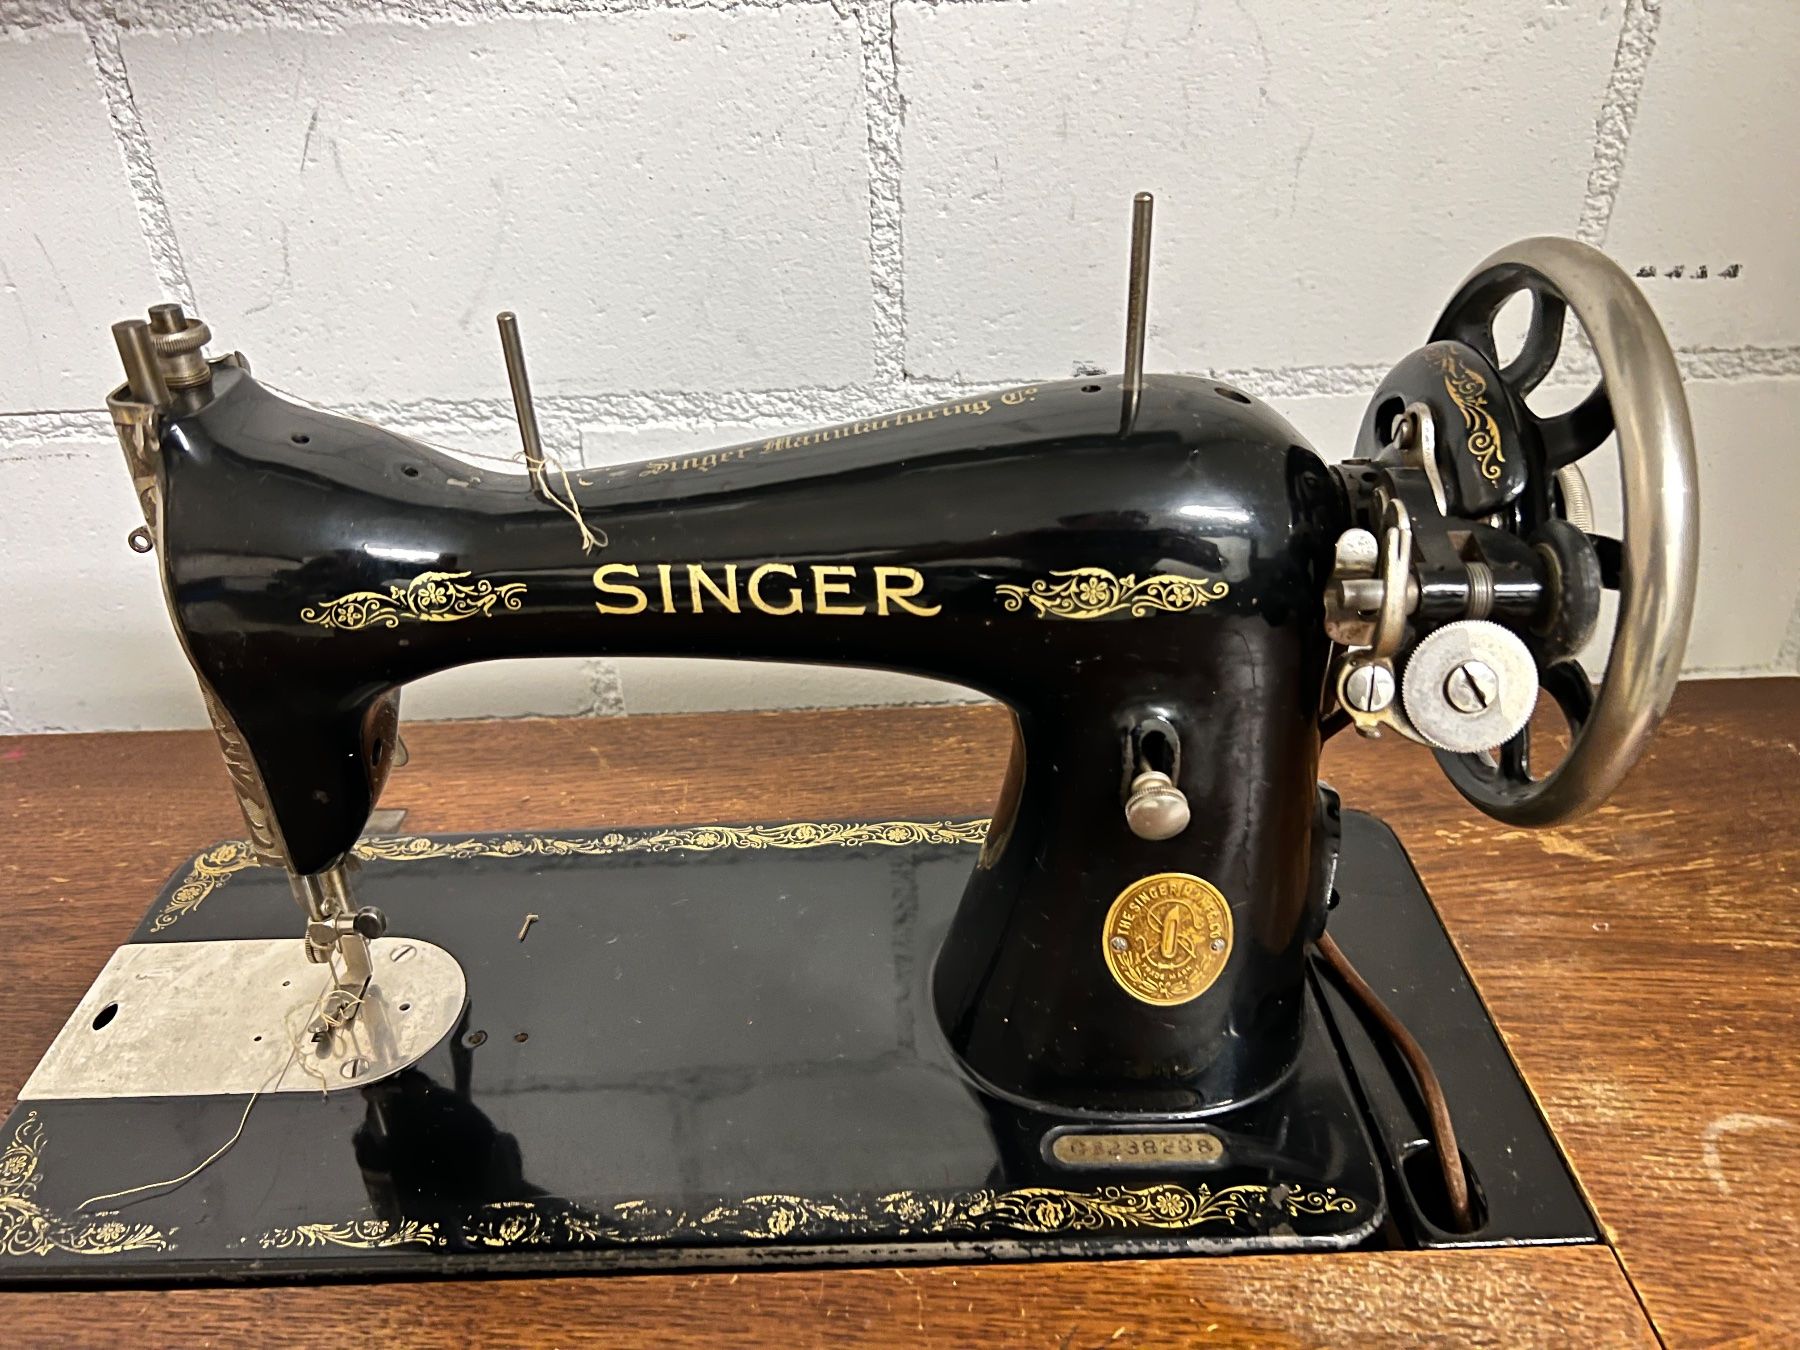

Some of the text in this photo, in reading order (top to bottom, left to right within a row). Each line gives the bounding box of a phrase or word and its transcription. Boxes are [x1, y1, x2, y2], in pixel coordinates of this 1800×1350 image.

[637, 447, 752, 478] Singer
[592, 562, 943, 617] SINGER
[1116, 910, 1136, 936] THE
[1129, 882, 1179, 914] SINGER
